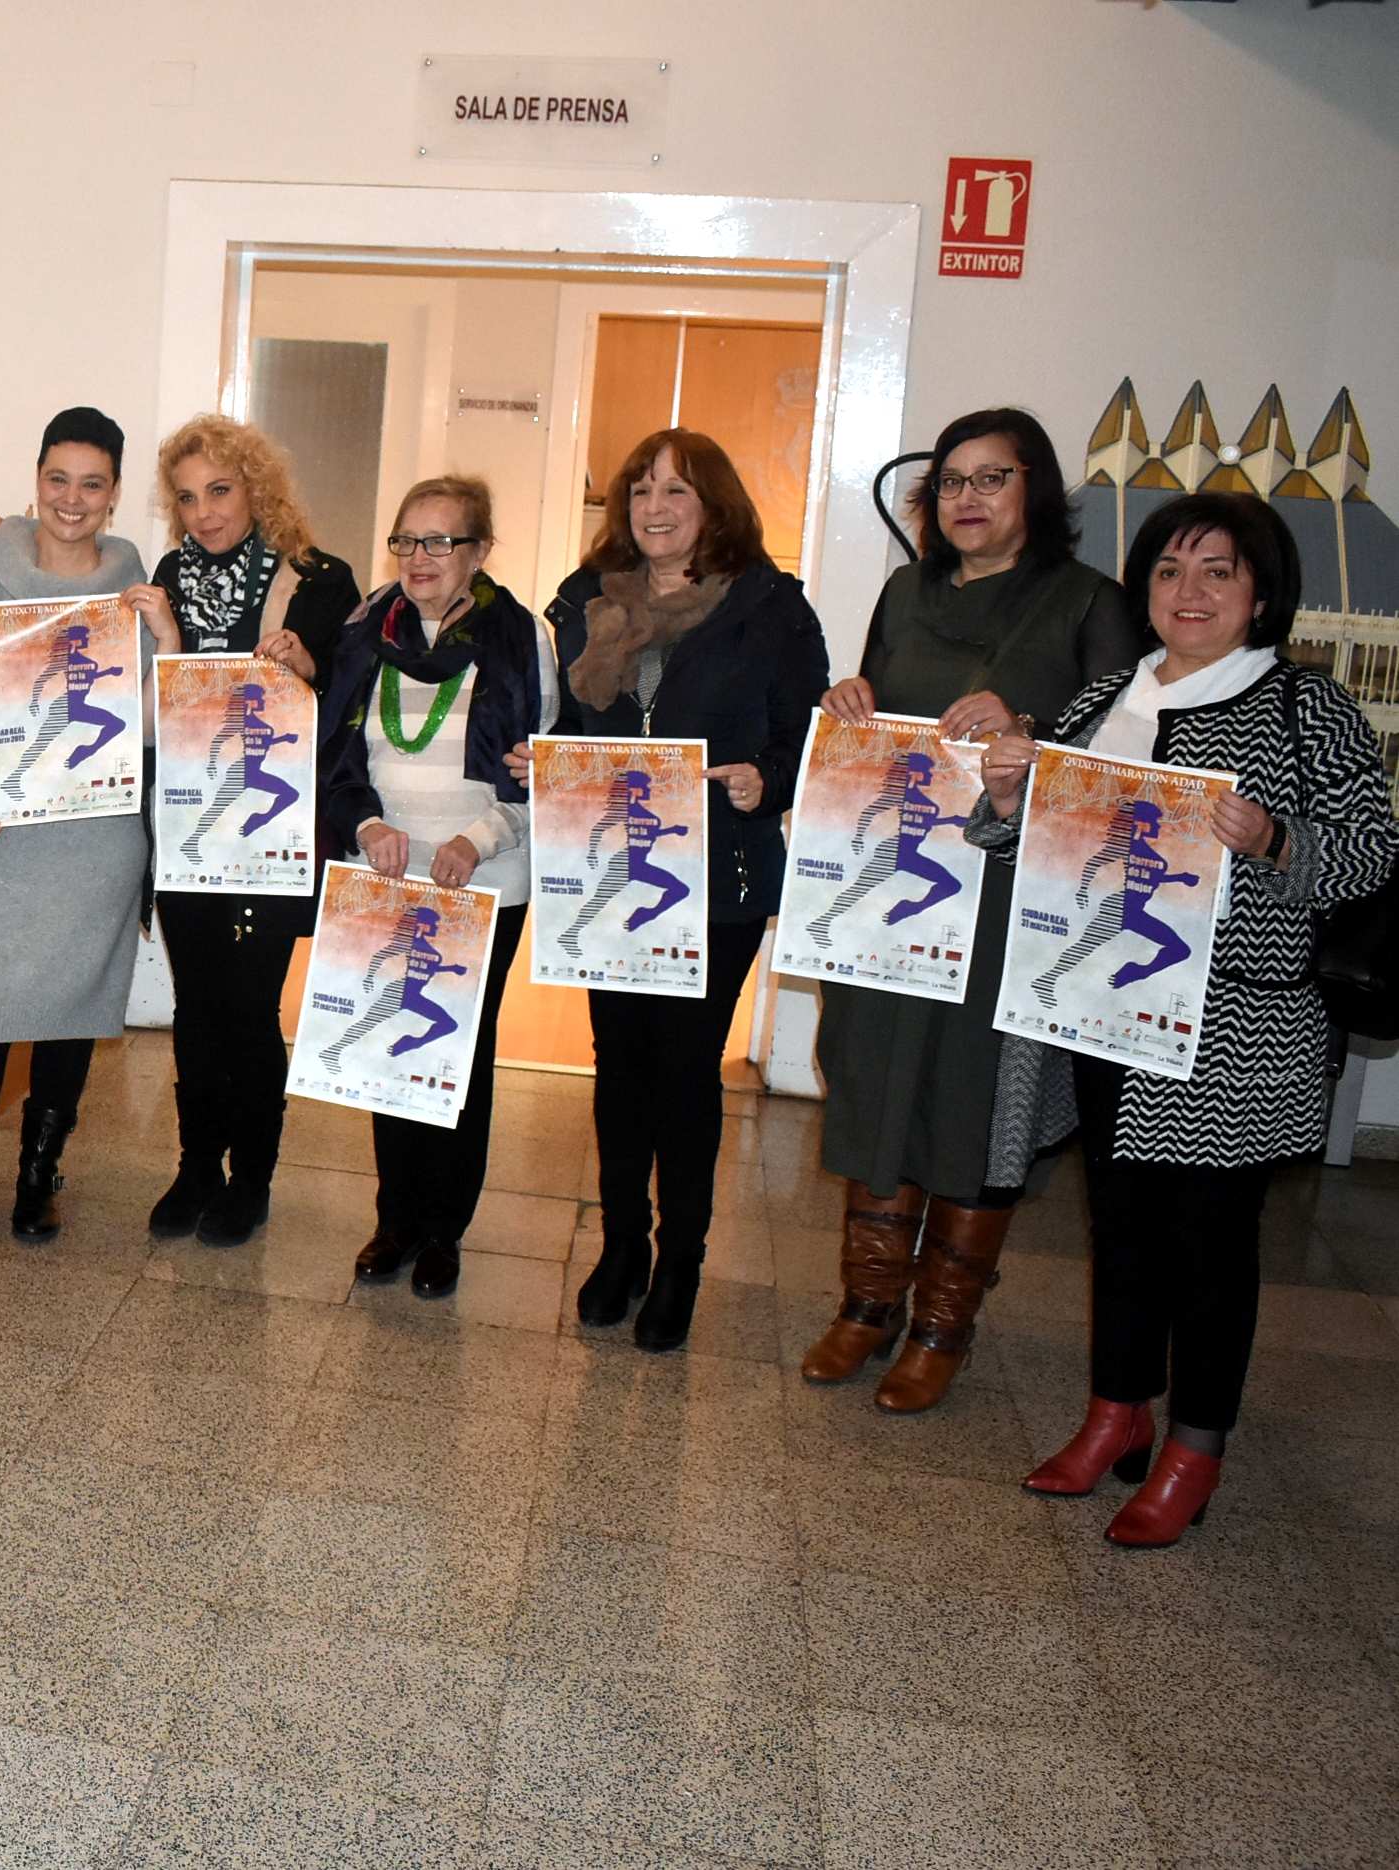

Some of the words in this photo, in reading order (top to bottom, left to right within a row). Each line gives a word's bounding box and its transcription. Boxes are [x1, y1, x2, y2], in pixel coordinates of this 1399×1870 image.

[455, 95, 507, 120] SALA
[513, 96, 540, 120] DE
[546, 97, 629, 123] PRENSA
[943, 252, 1020, 272] EXTINTOR
